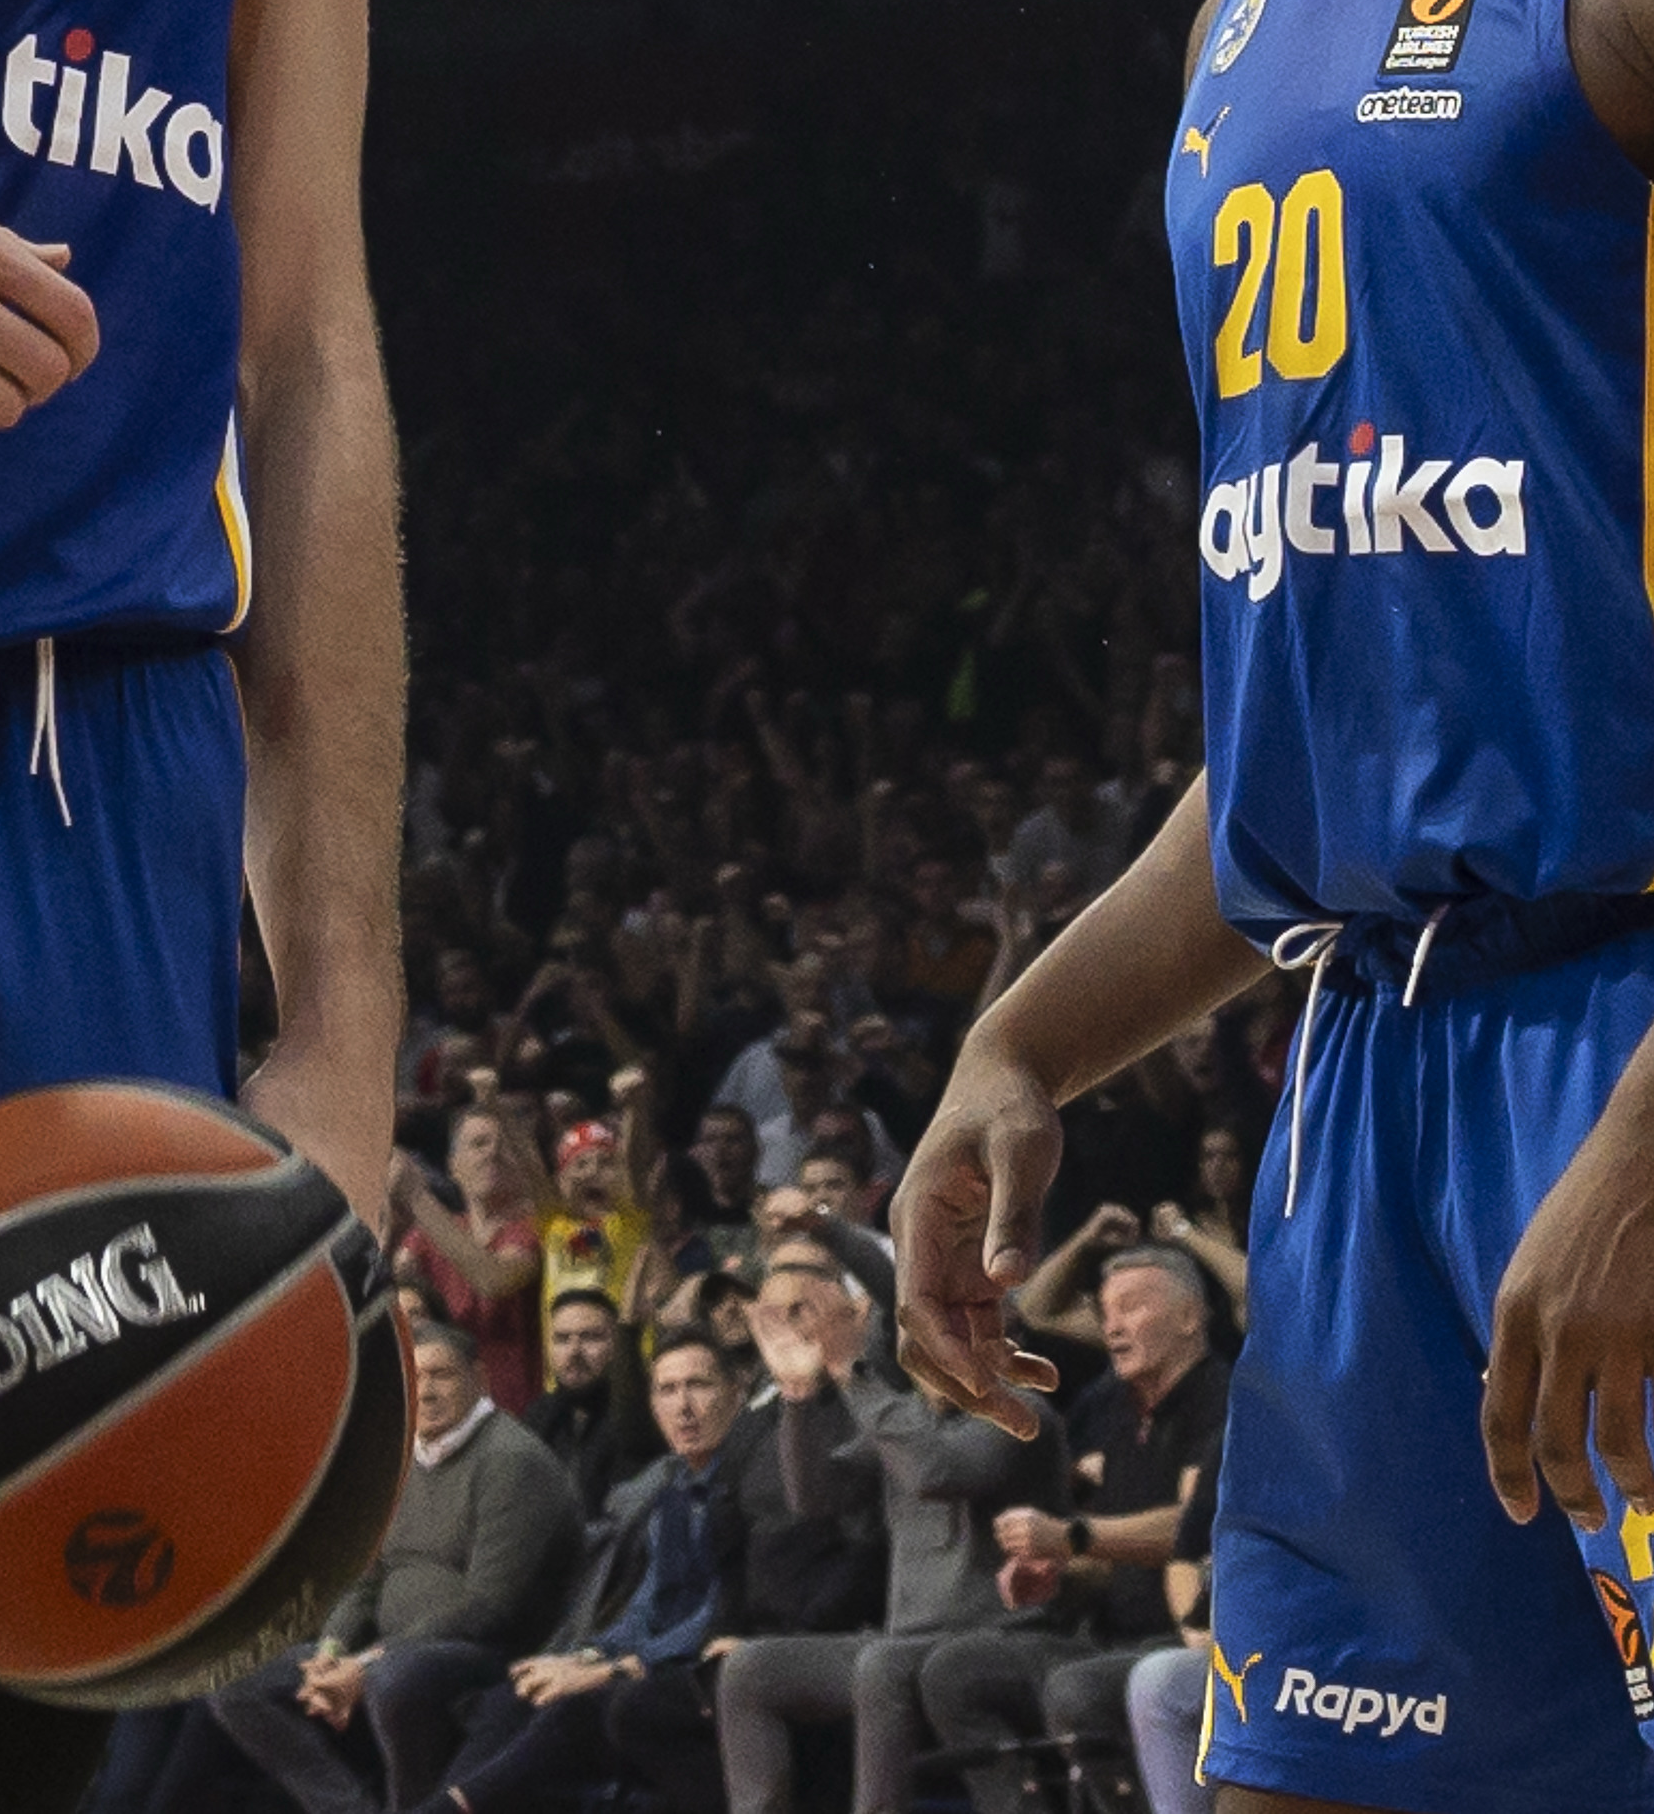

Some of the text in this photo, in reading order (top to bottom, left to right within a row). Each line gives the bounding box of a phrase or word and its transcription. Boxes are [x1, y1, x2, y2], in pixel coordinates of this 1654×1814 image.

[1360, 91, 1459, 118] oneteam
[1212, 168, 1347, 400] 20
[1199, 419, 1527, 604] aytika
[1273, 1667, 1448, 1737] Rapyd
